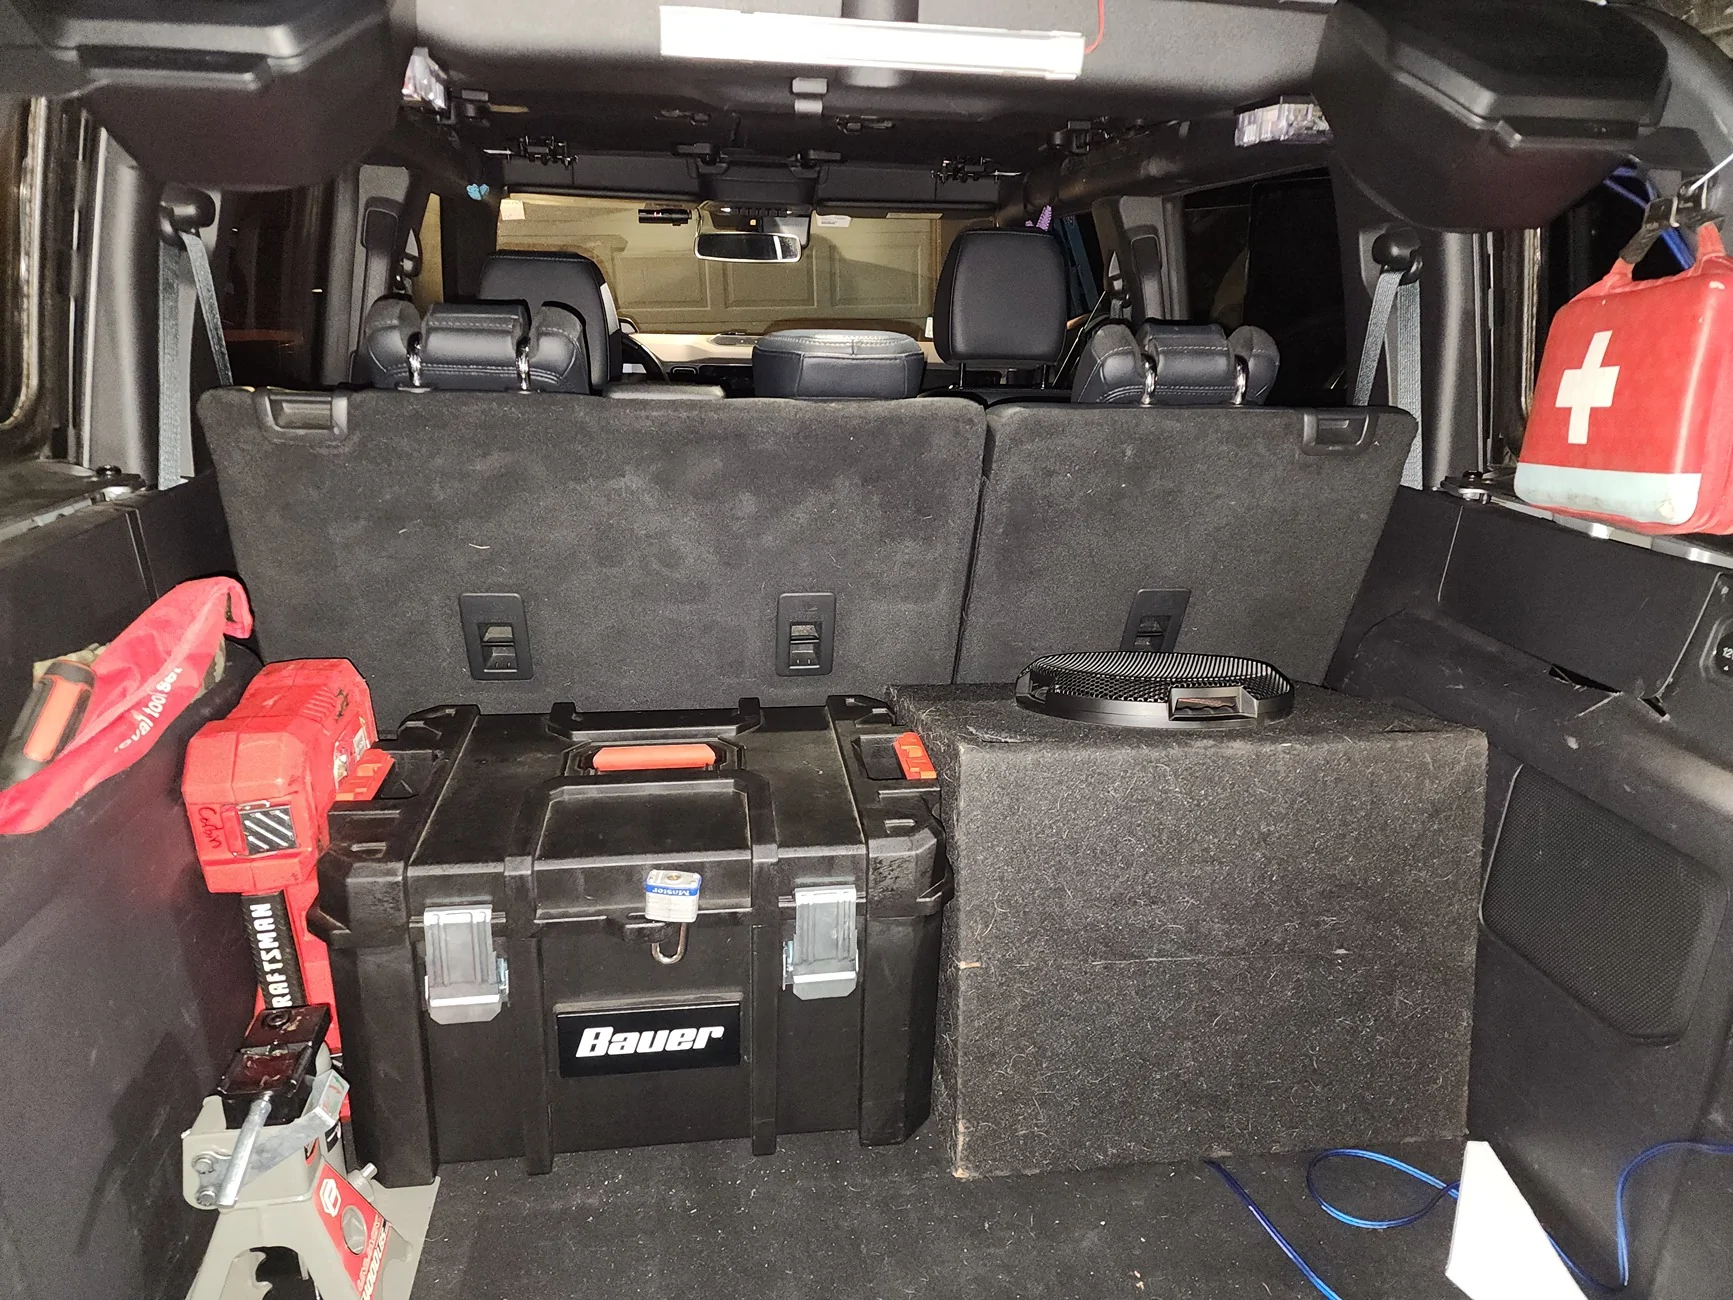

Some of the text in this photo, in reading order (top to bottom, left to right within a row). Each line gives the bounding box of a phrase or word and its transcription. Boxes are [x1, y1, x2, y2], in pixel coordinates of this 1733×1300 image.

[1722, 646, 1733, 660] 12
[141, 691, 168, 719] tool
[249, 903, 293, 1009] RAFTSMAN
[575, 1025, 725, 1058] Bauer
